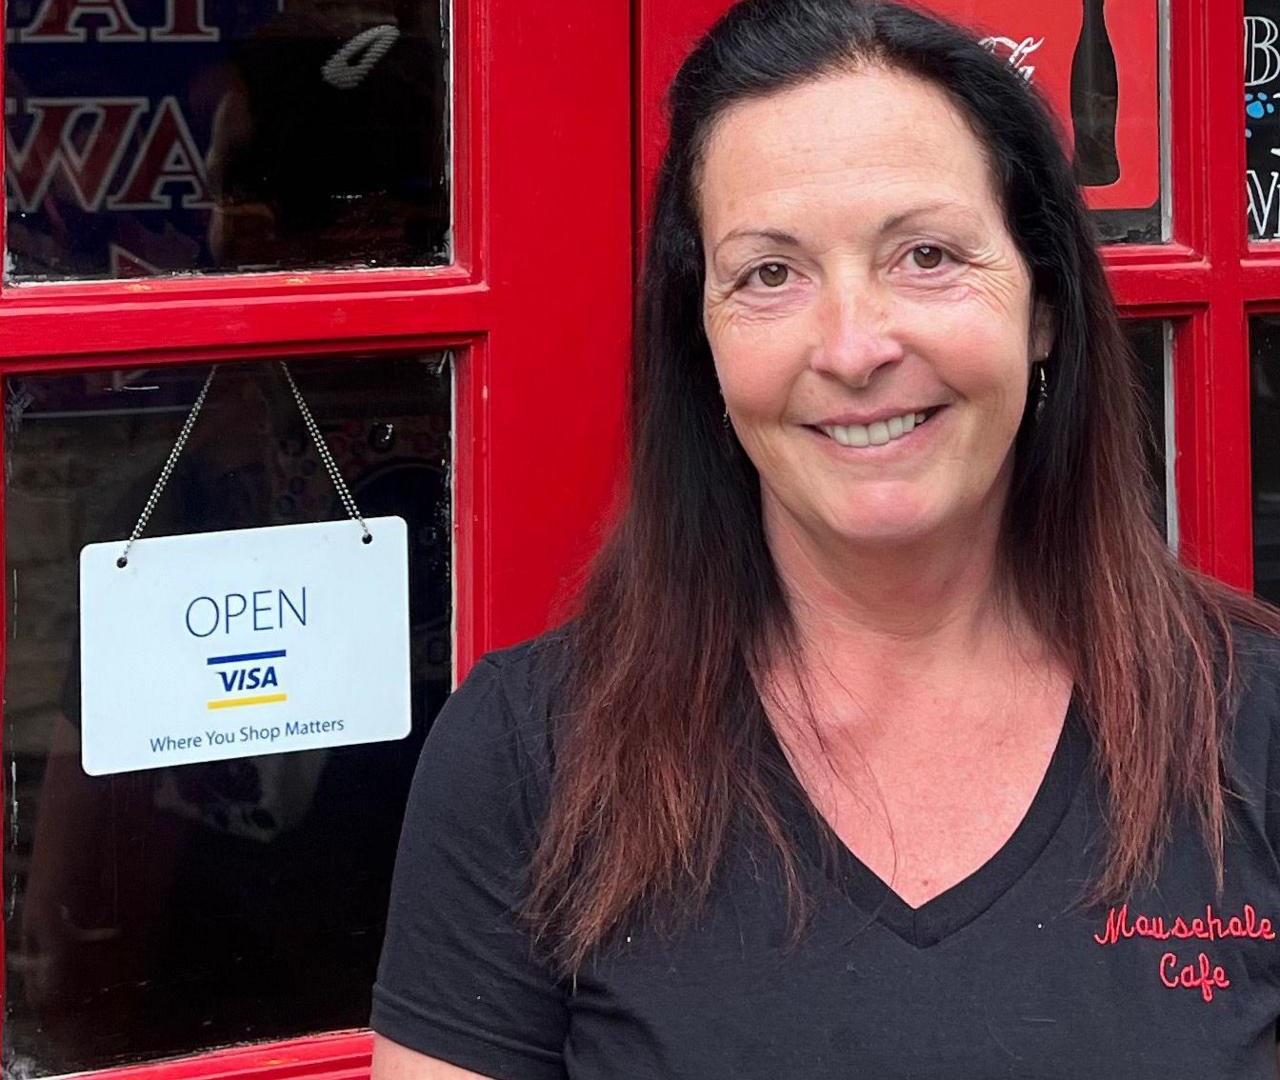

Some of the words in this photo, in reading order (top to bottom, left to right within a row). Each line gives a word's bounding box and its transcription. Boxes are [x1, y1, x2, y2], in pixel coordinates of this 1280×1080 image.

[185, 586, 307, 638] OPEN
[216, 666, 278, 692] VISA
[150, 737, 202, 752] Where
[206, 730, 236, 746] You
[239, 725, 281, 741] Shop
[285, 719, 345, 737] Matters
[1160, 952, 1230, 1002] Cafe
